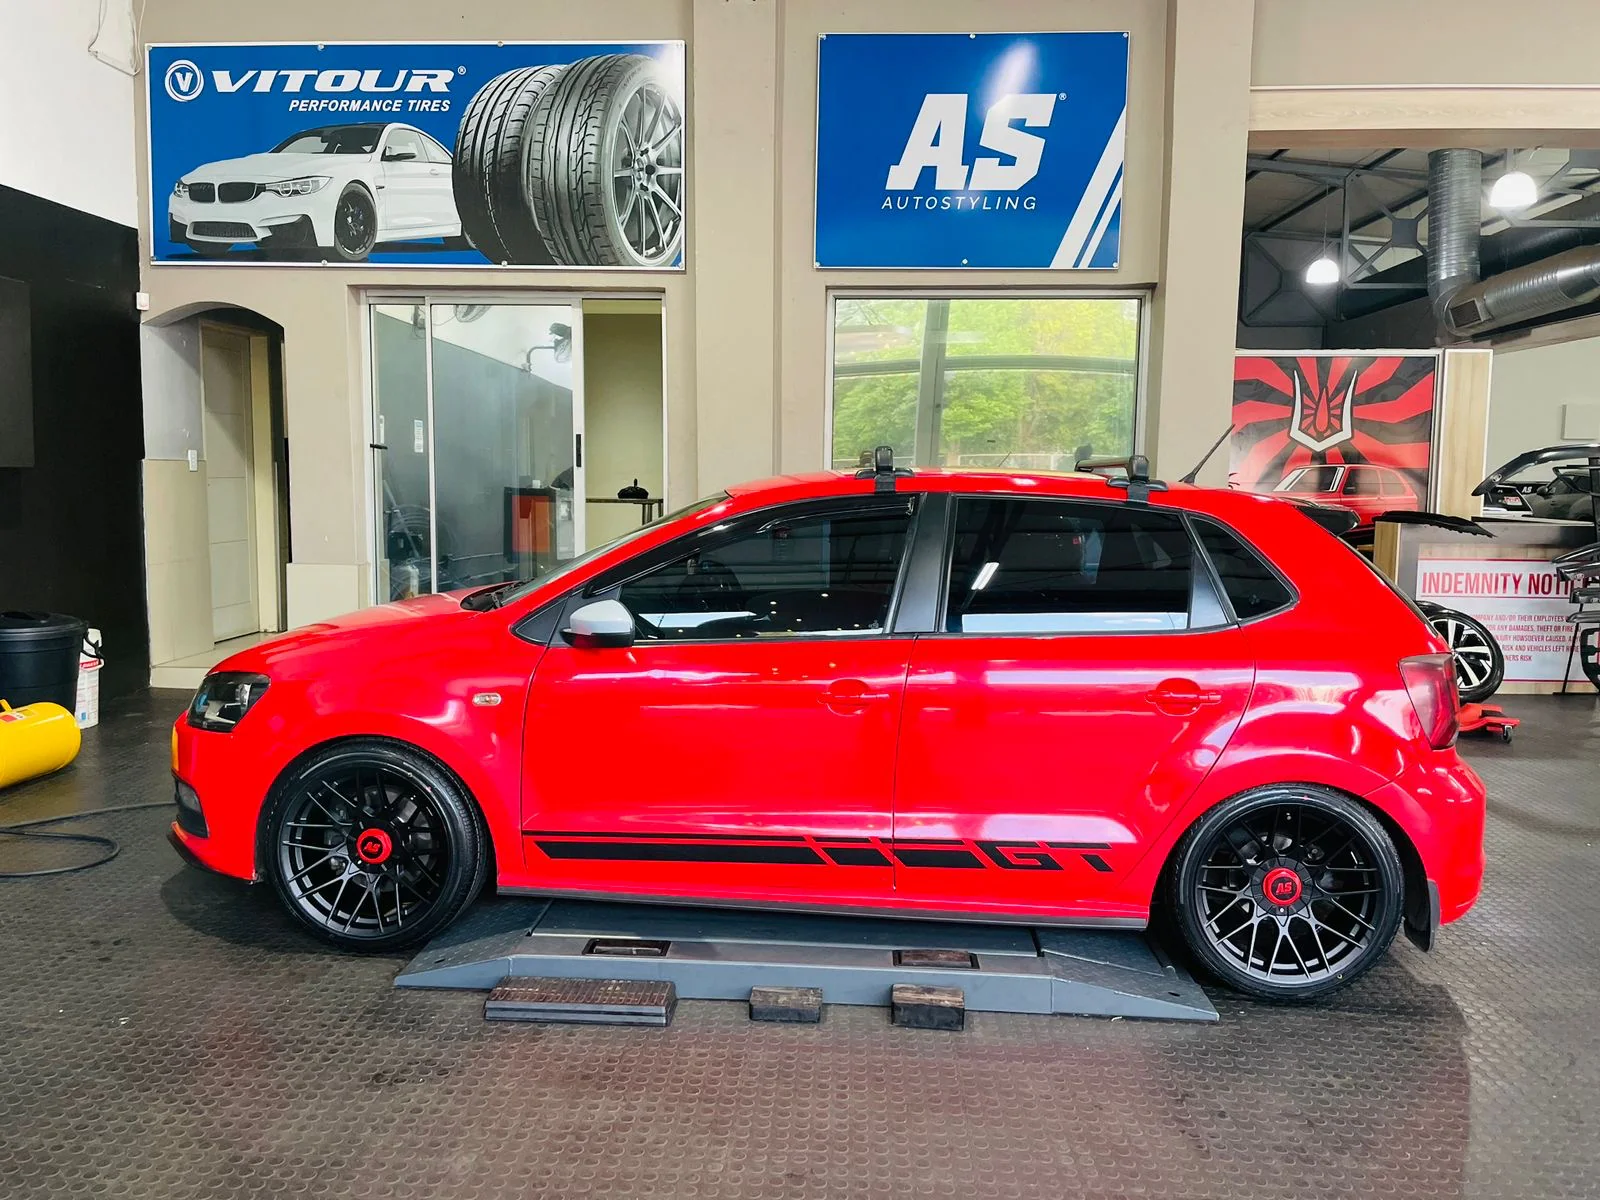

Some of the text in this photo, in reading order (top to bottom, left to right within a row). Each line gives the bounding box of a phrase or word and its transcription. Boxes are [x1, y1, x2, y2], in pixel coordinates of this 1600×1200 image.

[211, 69, 455, 93] VITOUR
[288, 99, 451, 112] PERFORMANCE TIRES
[885, 93, 1058, 190] AS
[881, 196, 1037, 210] AUTOSTYLING
[1422, 572, 1575, 596] INDEMNITY NOTI
[1526, 645, 1552, 653] VEHICLES
[1275, 880, 1293, 895] AS
